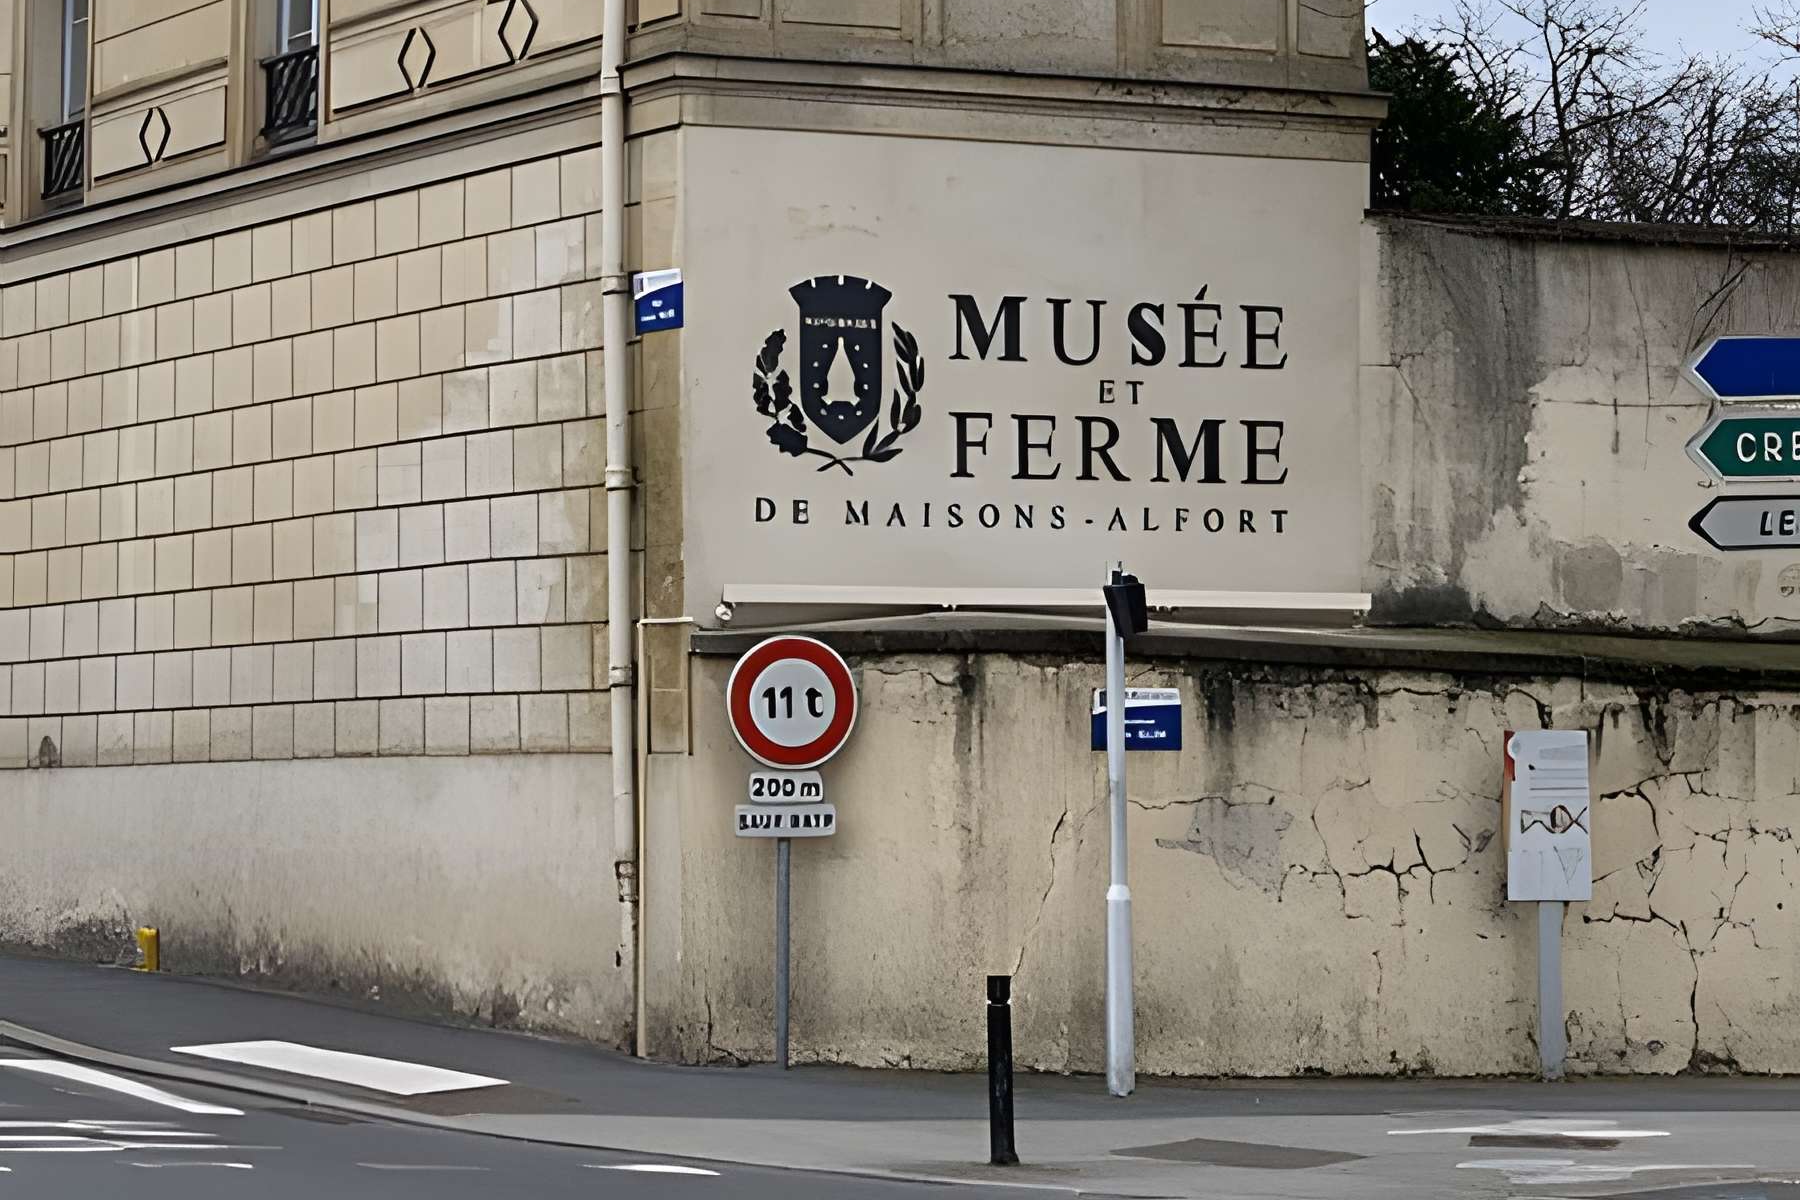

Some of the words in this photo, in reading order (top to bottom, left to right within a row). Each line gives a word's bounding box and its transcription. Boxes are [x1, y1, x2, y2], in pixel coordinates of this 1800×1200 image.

[947, 283, 1289, 370] MUSÉE
[1099, 379, 1145, 405] ET
[948, 411, 1290, 485] FERME
[755, 496, 810, 525] DE
[844, 499, 1290, 534] MAISONS-ALFORT
[761, 686, 793, 719] 11
[805, 687, 824, 719] t
[752, 777, 796, 797] 200
[800, 782, 820, 797] m
